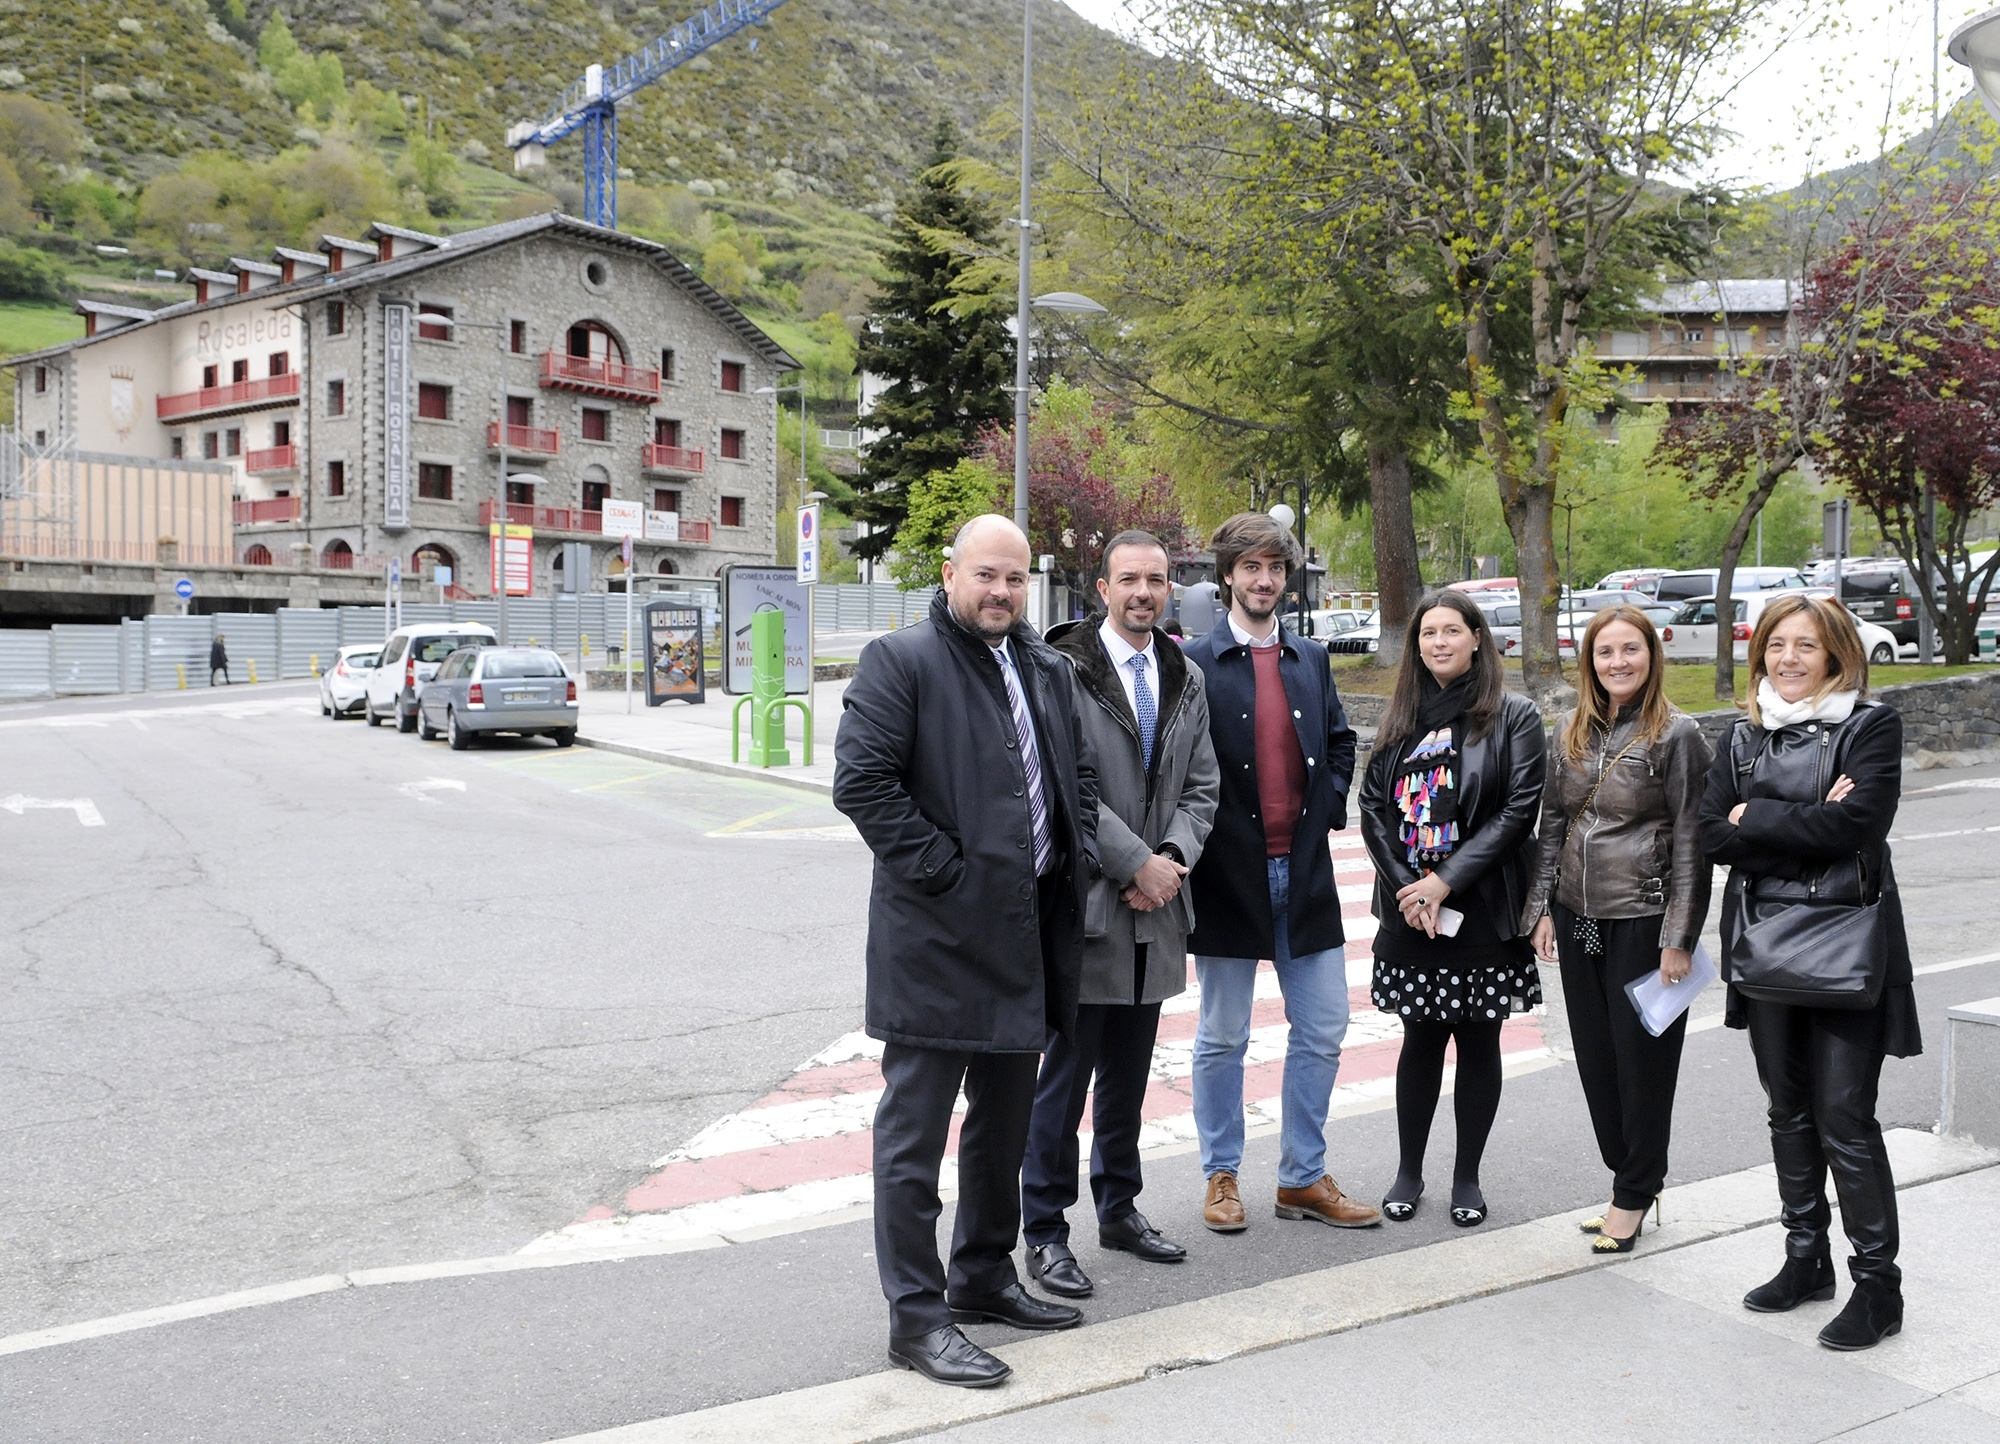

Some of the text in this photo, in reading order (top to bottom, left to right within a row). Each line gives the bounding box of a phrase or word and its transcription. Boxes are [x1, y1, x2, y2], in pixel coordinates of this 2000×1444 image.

[197, 311, 291, 353] Rosaleda
[390, 308, 403, 511] HOTEL ROSALEDA
[736, 572, 764, 581] NOMÉS
[765, 573, 771, 581] A
[774, 594, 784, 603] AL
